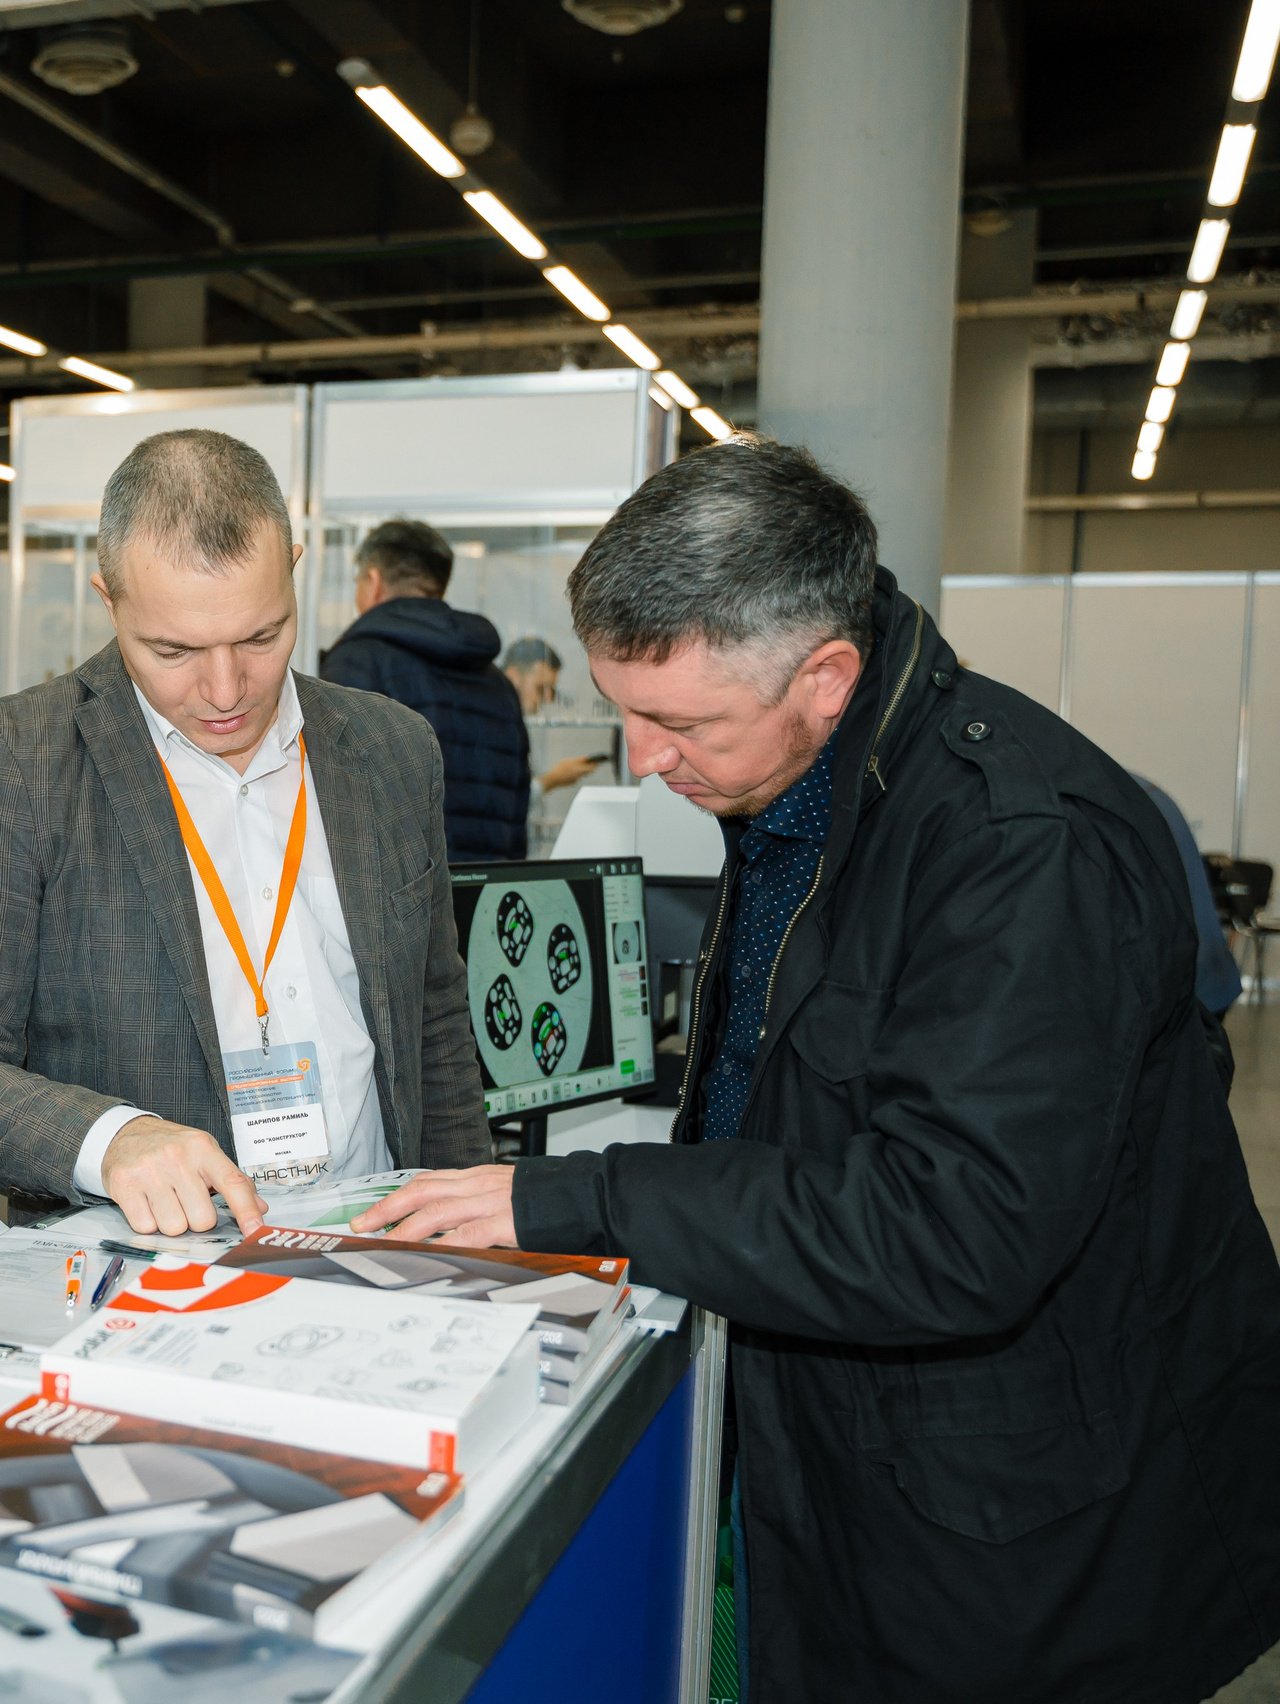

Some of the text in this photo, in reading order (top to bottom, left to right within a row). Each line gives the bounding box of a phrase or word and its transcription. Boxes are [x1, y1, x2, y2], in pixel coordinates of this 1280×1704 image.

[247, 1112, 309, 1126] ШАРИПОВ РАМИЛЬ
[266, 1131, 308, 1142] "КОНСТРУКТОР"
